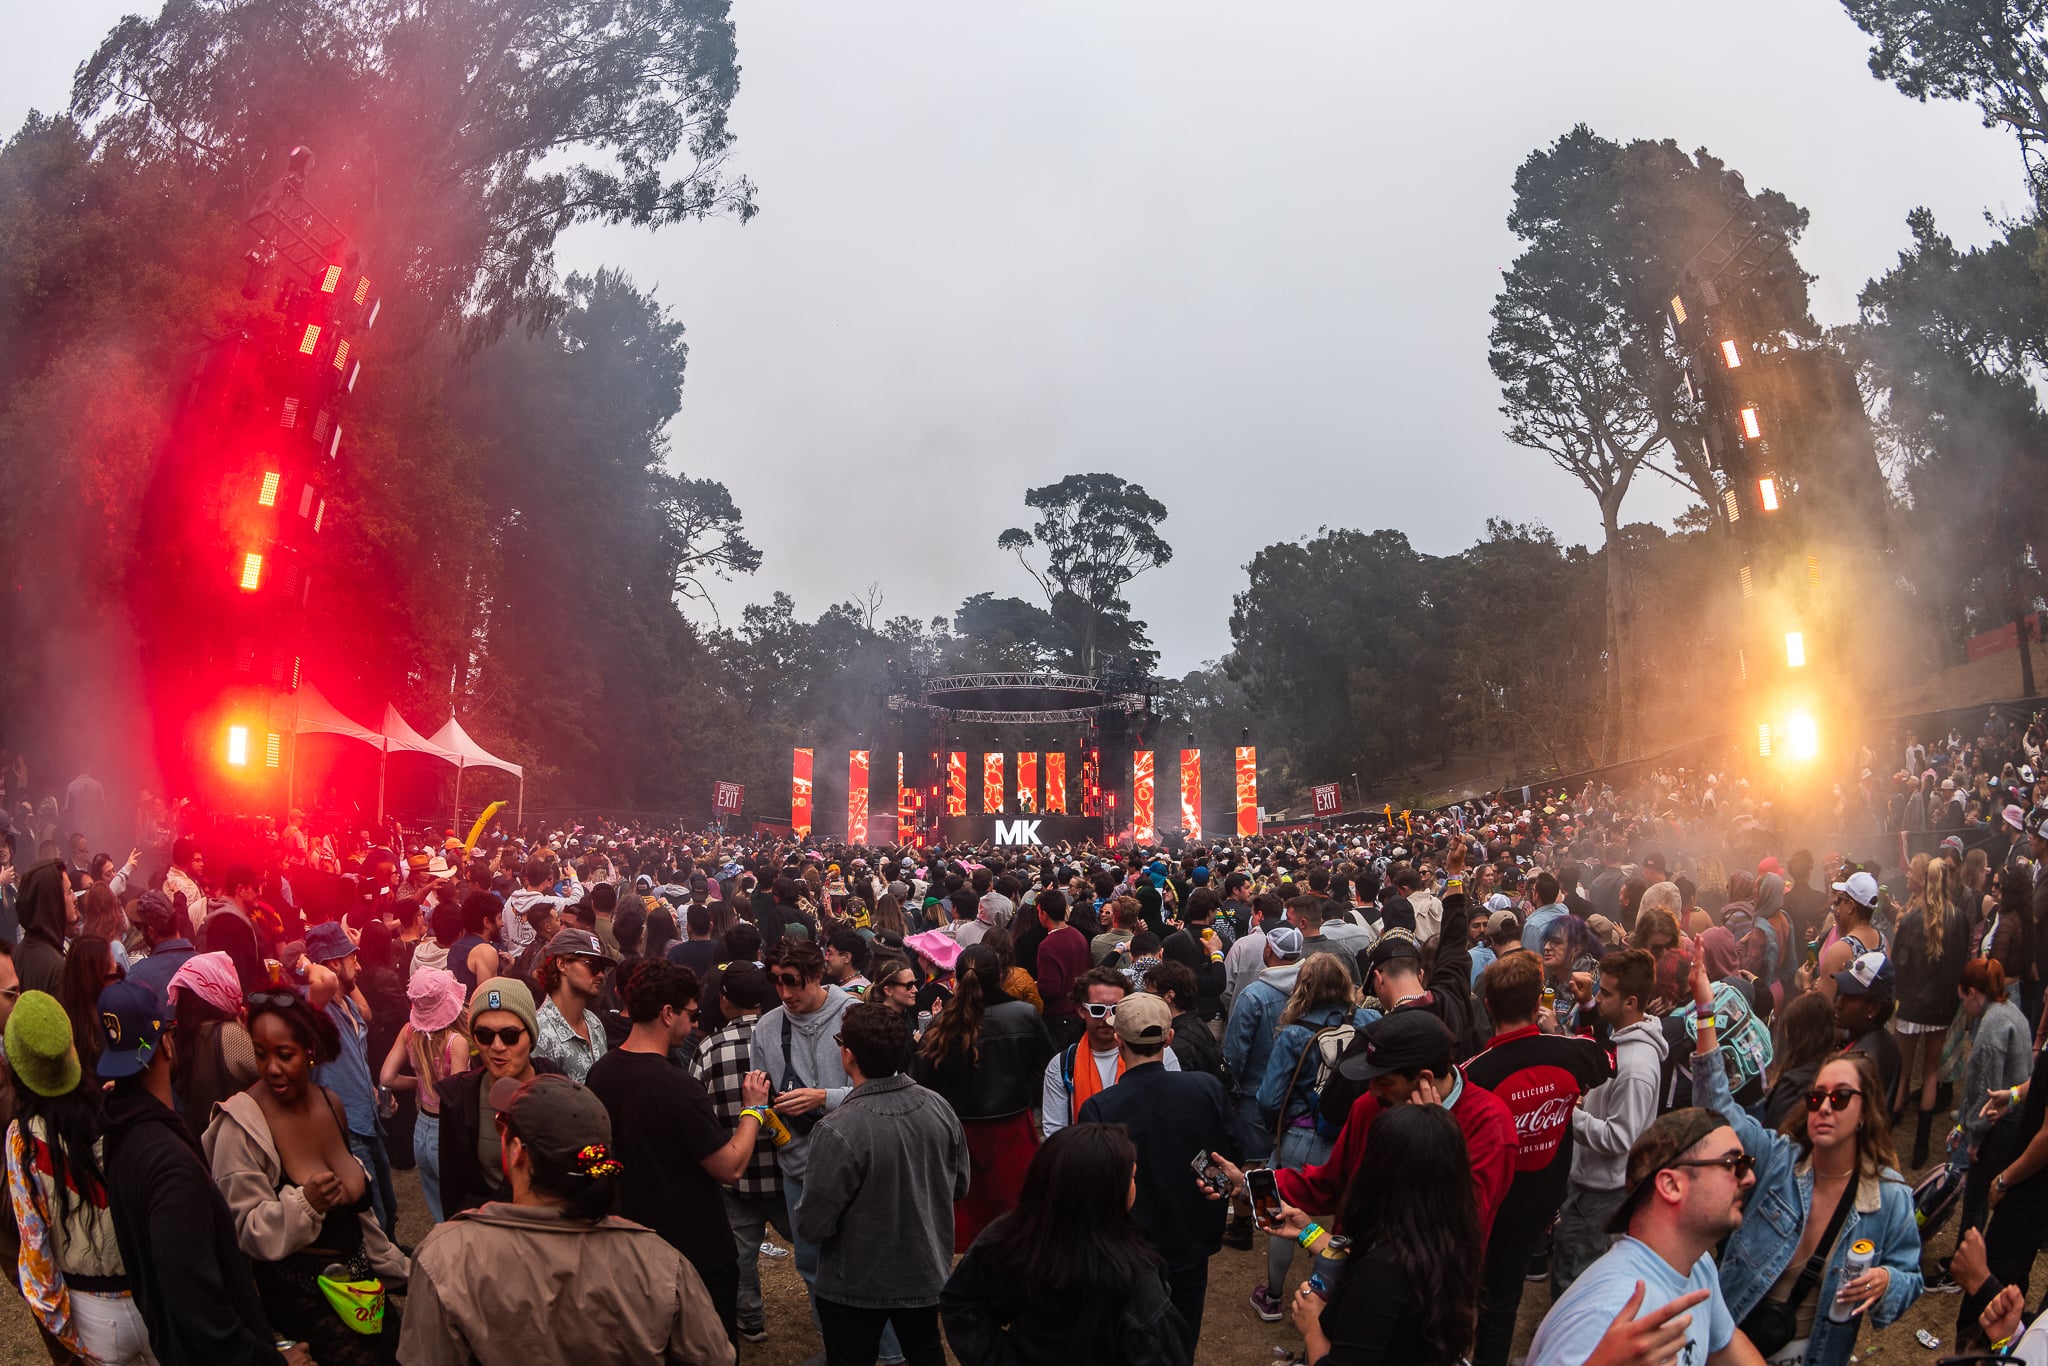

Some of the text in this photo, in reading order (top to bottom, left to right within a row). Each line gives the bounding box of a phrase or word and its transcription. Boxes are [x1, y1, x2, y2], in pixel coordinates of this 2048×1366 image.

[717, 790, 740, 809] EXIT
[1316, 791, 1337, 811] EXIT
[995, 819, 1043, 846] MK
[1511, 1083, 1555, 1101] DELICIOUS
